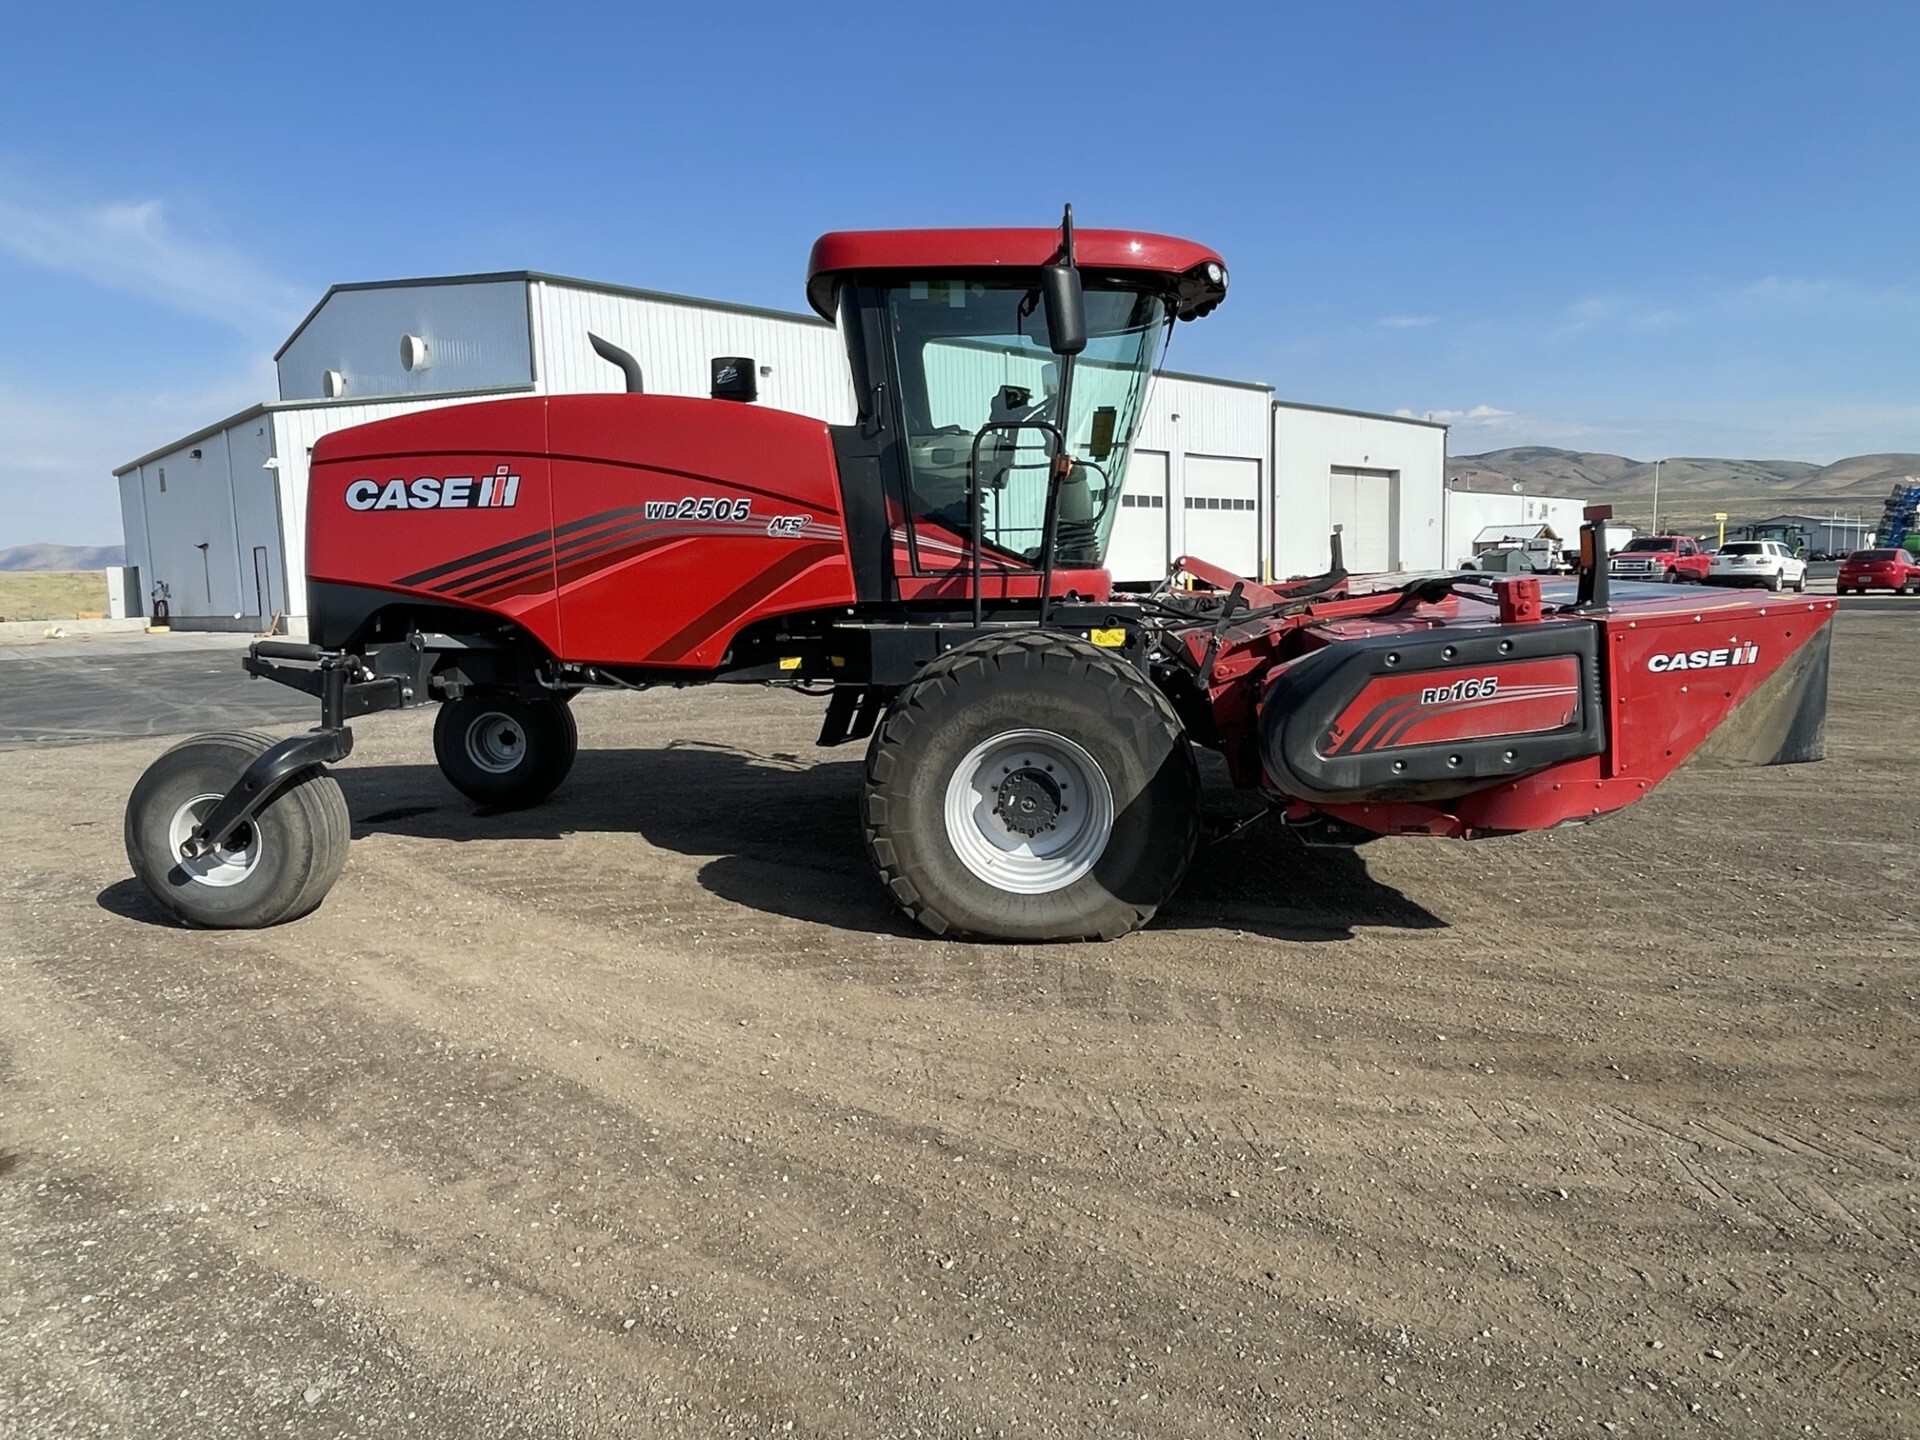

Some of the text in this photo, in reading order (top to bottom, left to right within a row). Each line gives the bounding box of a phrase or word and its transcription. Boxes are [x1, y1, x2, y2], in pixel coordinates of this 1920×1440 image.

[345, 478, 473, 511] CASE
[645, 497, 751, 521] WD2505
[769, 515, 803, 530] AFS
[1647, 648, 1729, 673] CASE
[1421, 677, 1498, 704] RD165
